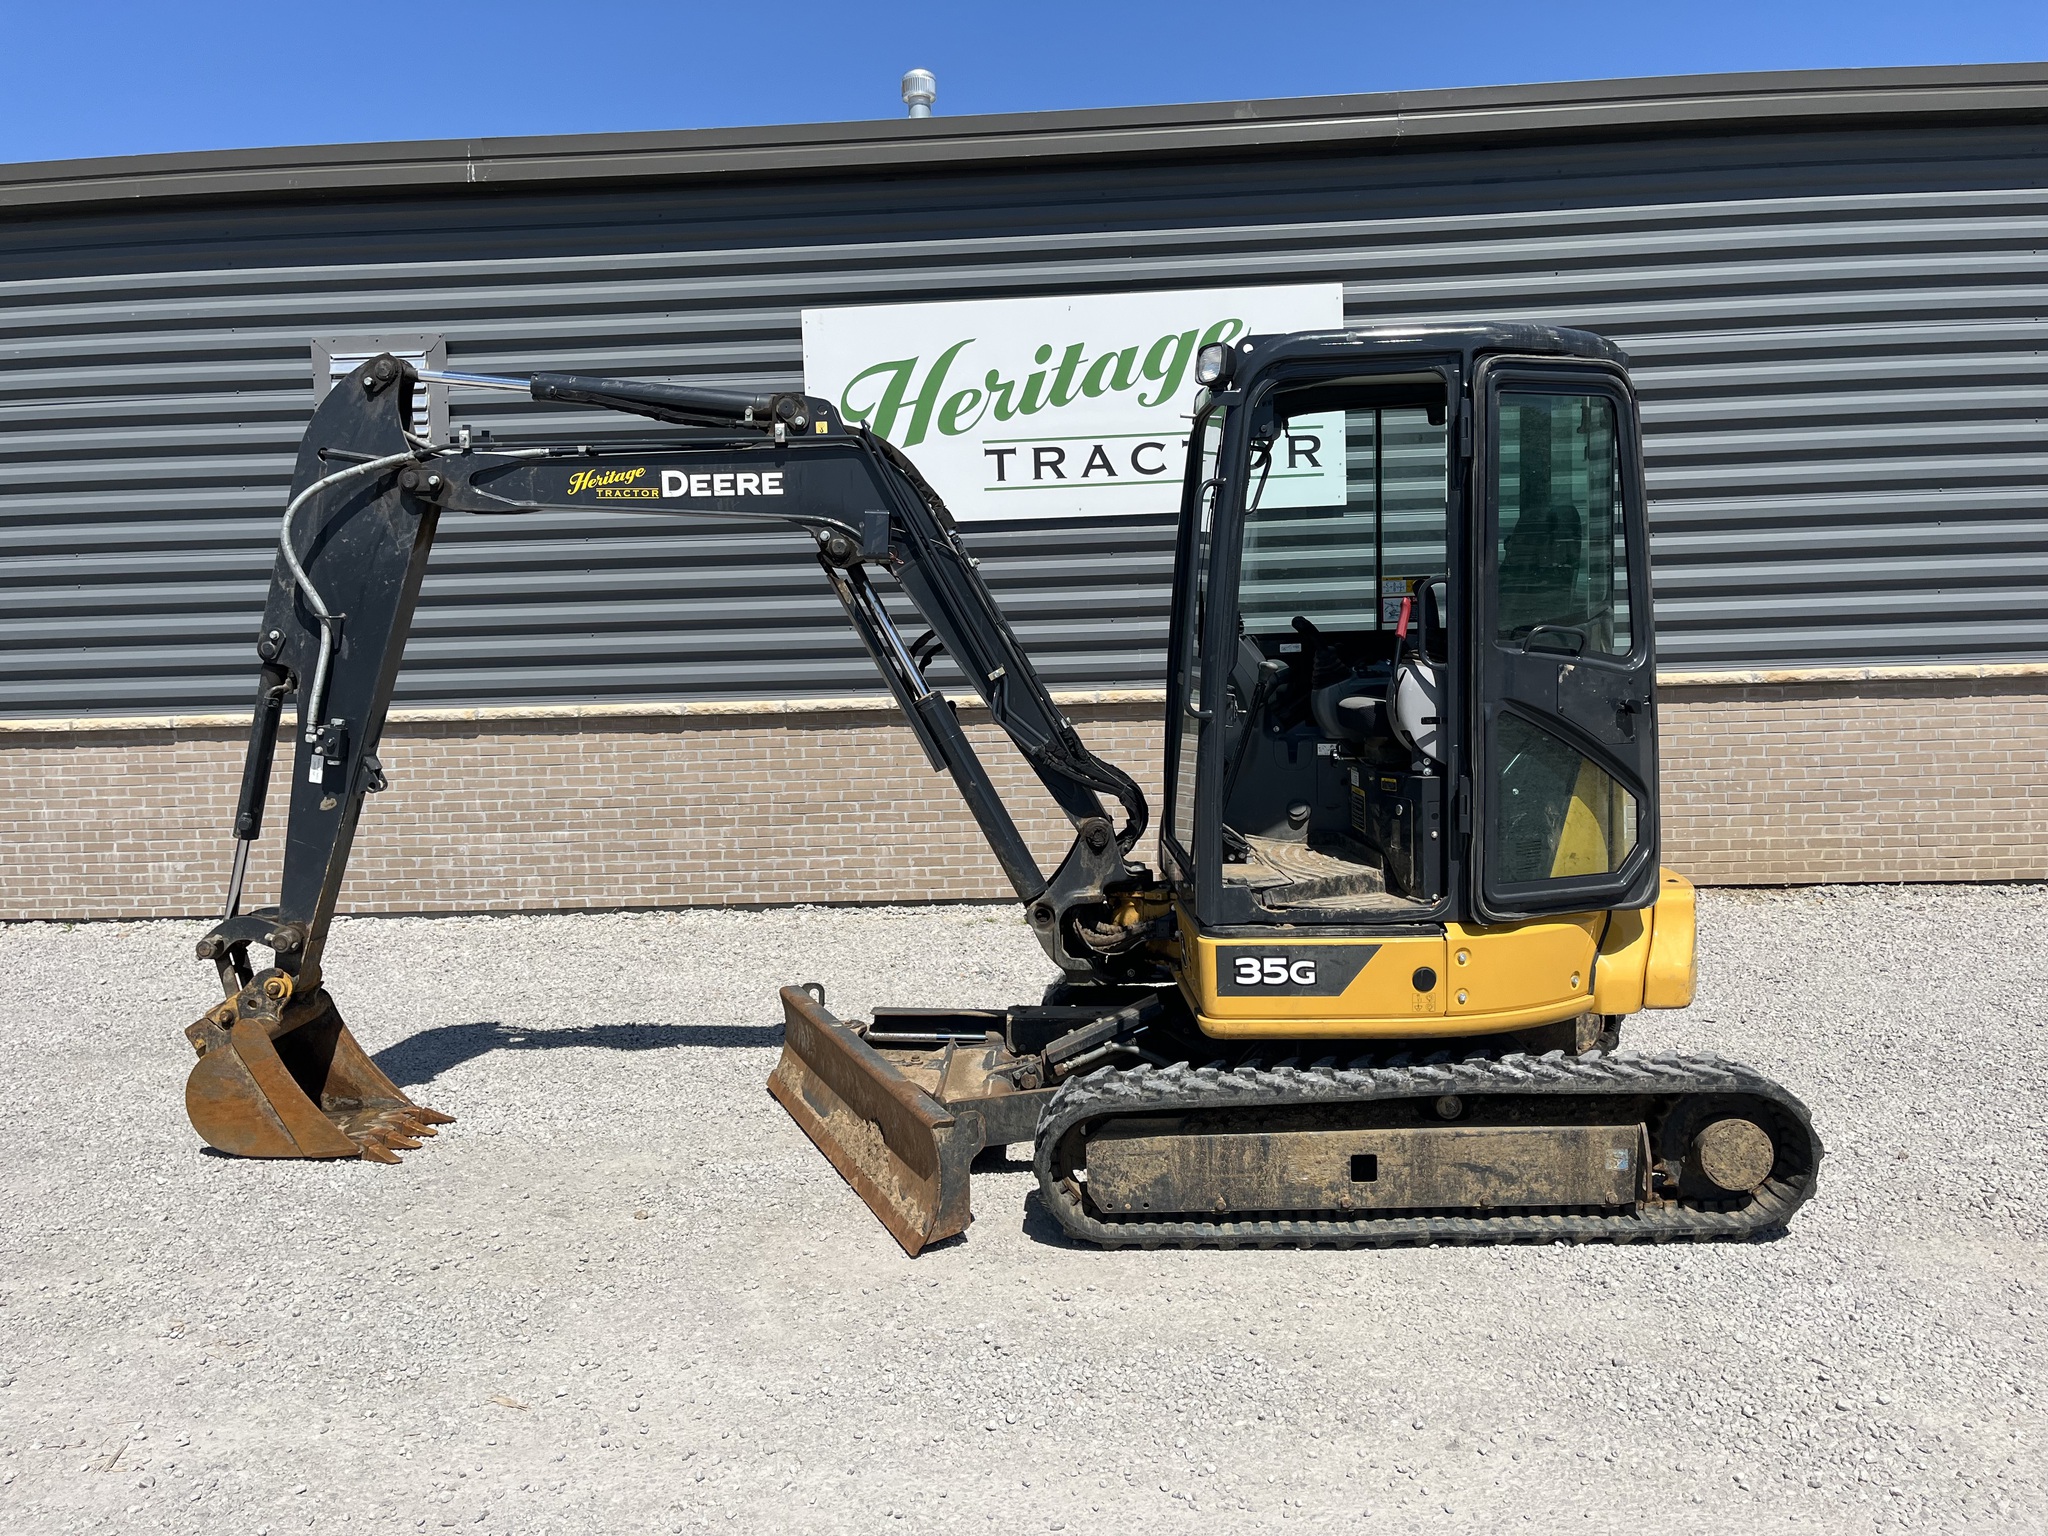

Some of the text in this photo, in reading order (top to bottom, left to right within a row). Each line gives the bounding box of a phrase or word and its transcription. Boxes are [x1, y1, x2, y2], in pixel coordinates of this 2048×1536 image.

[983, 434, 1322, 482] TRACR
[567, 467, 647, 495] Heritage
[596, 488, 660, 498] TRACTOR
[660, 469, 784, 498] DEERE
[1234, 956, 1317, 985] 35G
